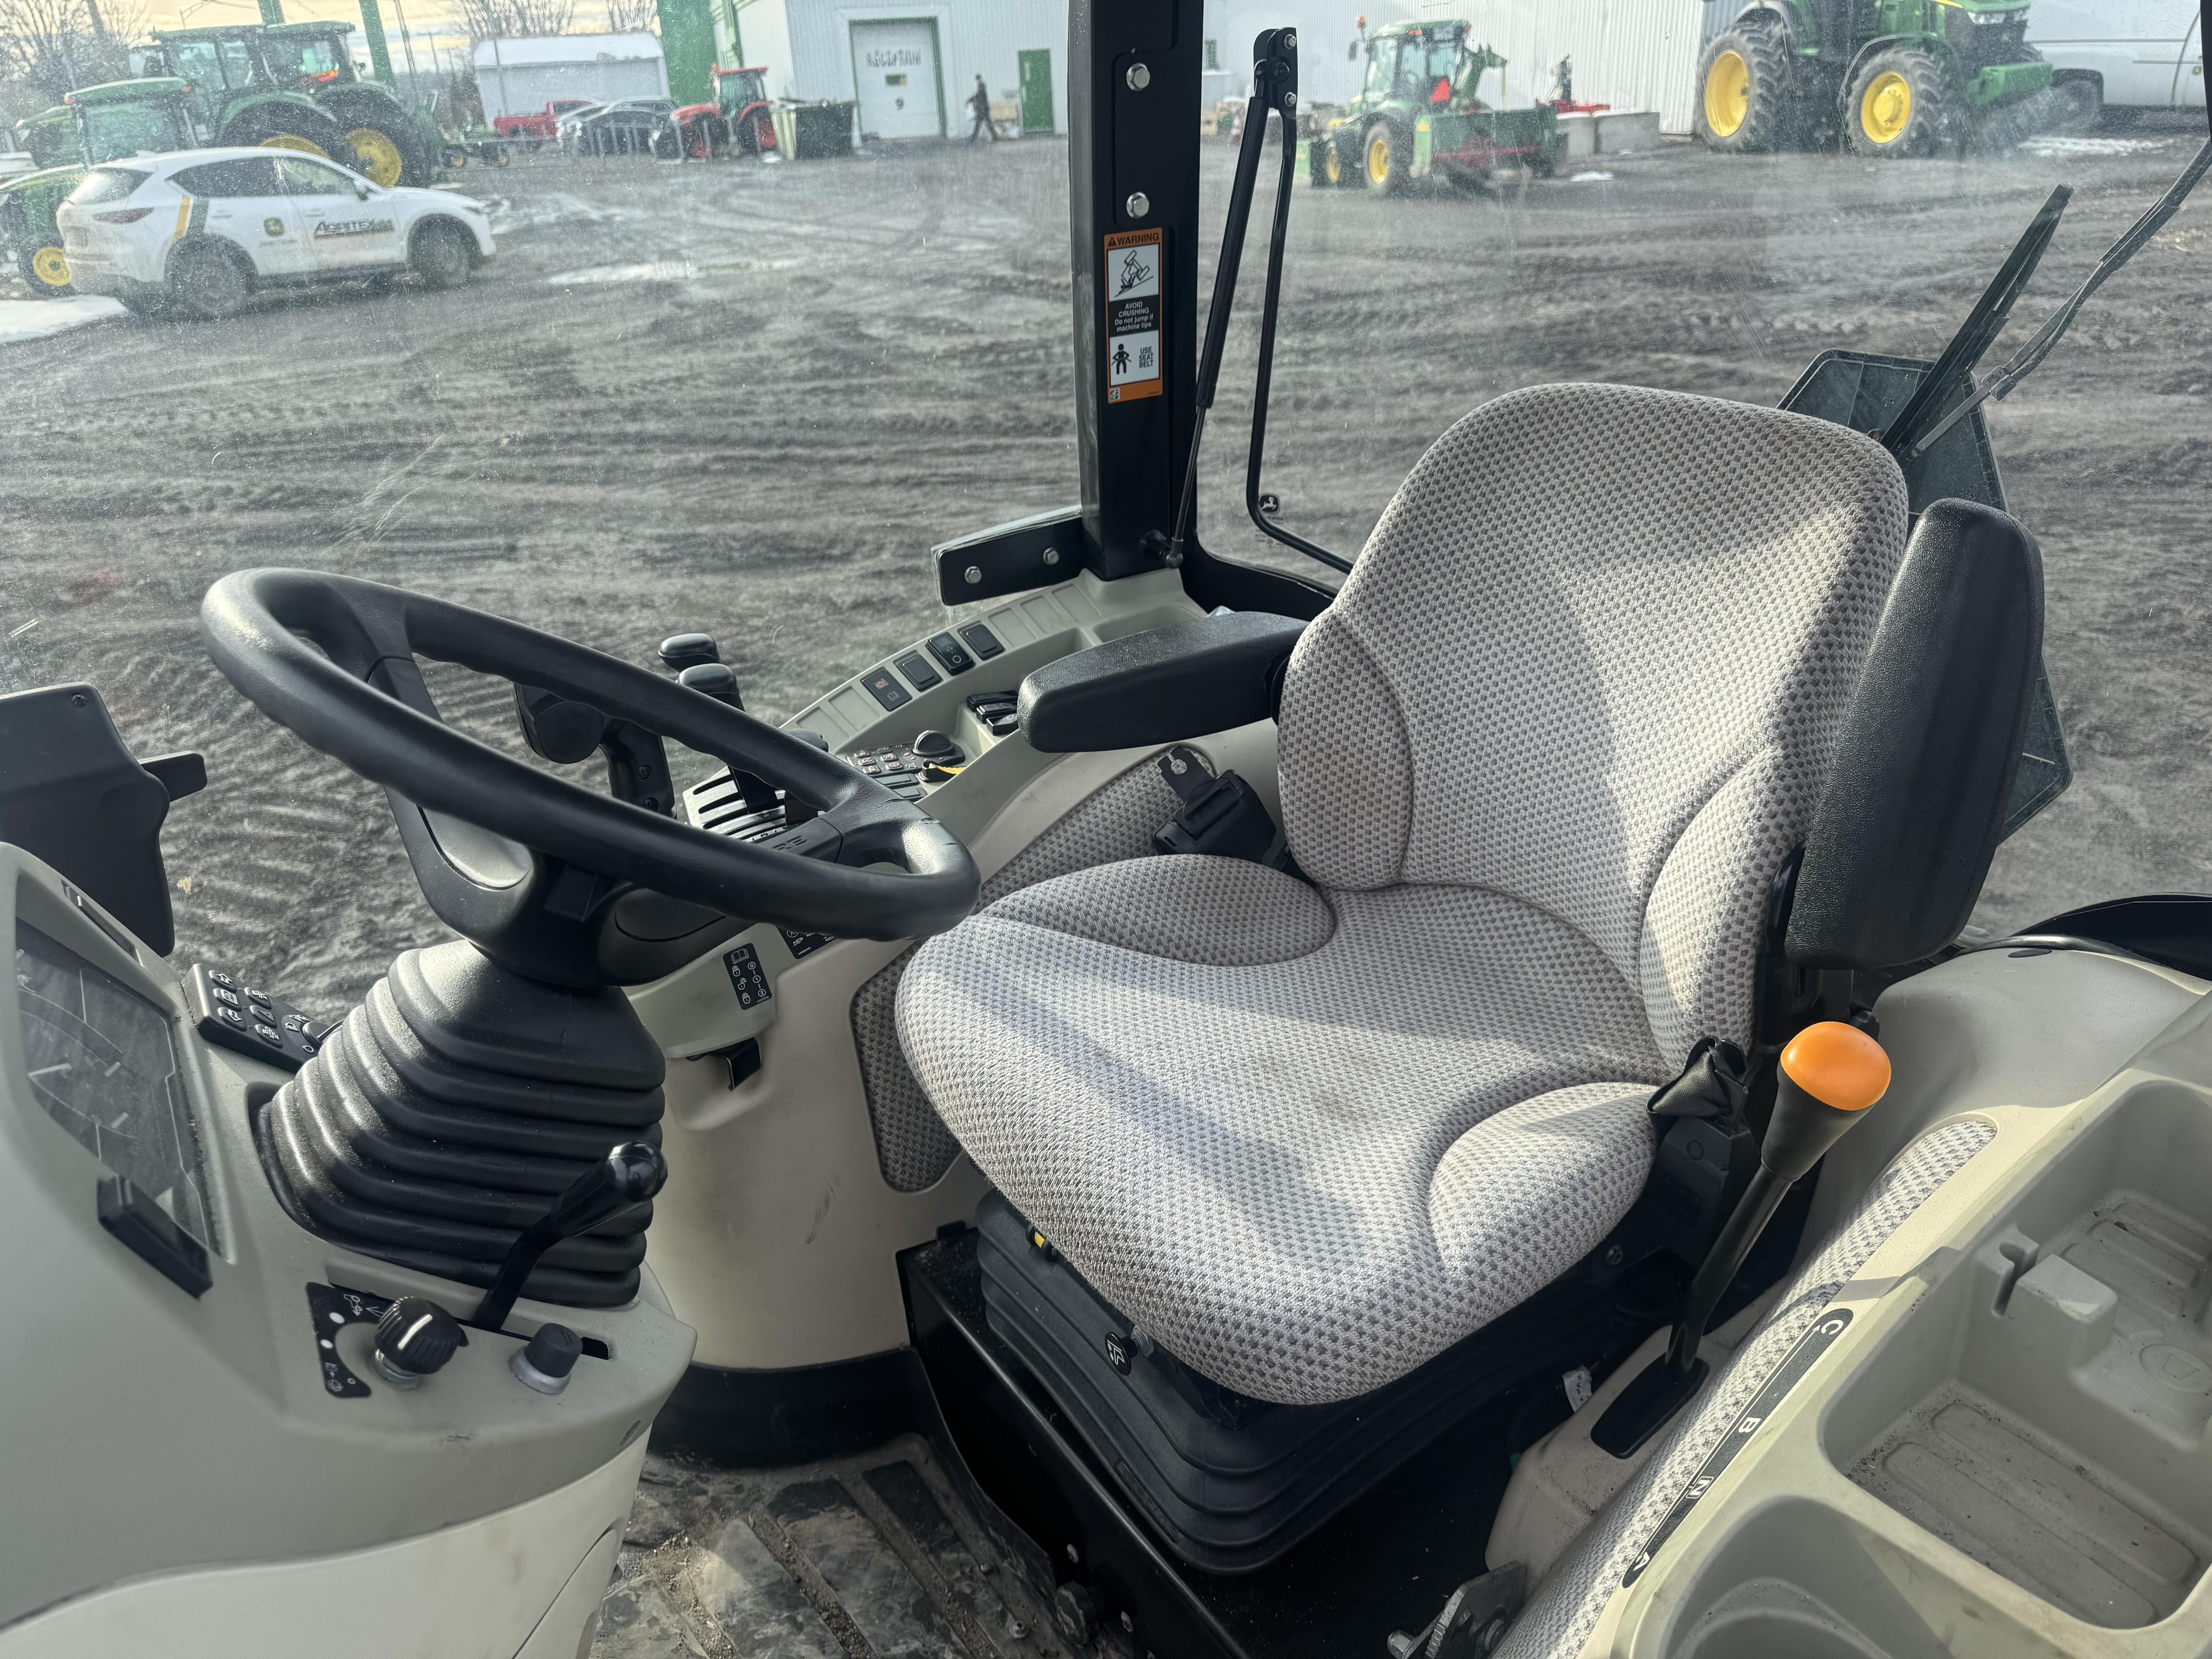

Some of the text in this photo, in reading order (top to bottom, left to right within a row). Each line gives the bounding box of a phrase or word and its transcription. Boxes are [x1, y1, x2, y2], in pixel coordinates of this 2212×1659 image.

[895, 98, 905, 110] 9
[1118, 233, 1159, 246] WARNING
[1125, 302, 1143, 310] AVOID
[1118, 307, 1149, 318] CRUSHING
[1134, 316, 1149, 324] jump
[1140, 346, 1152, 354] USE
[1139, 353, 1154, 362] SEAT
[1821, 1320, 1844, 1335] C
[1738, 1417, 1761, 1433] B
[1689, 1479, 1711, 1495] N
[1633, 1551, 1650, 1571] A
